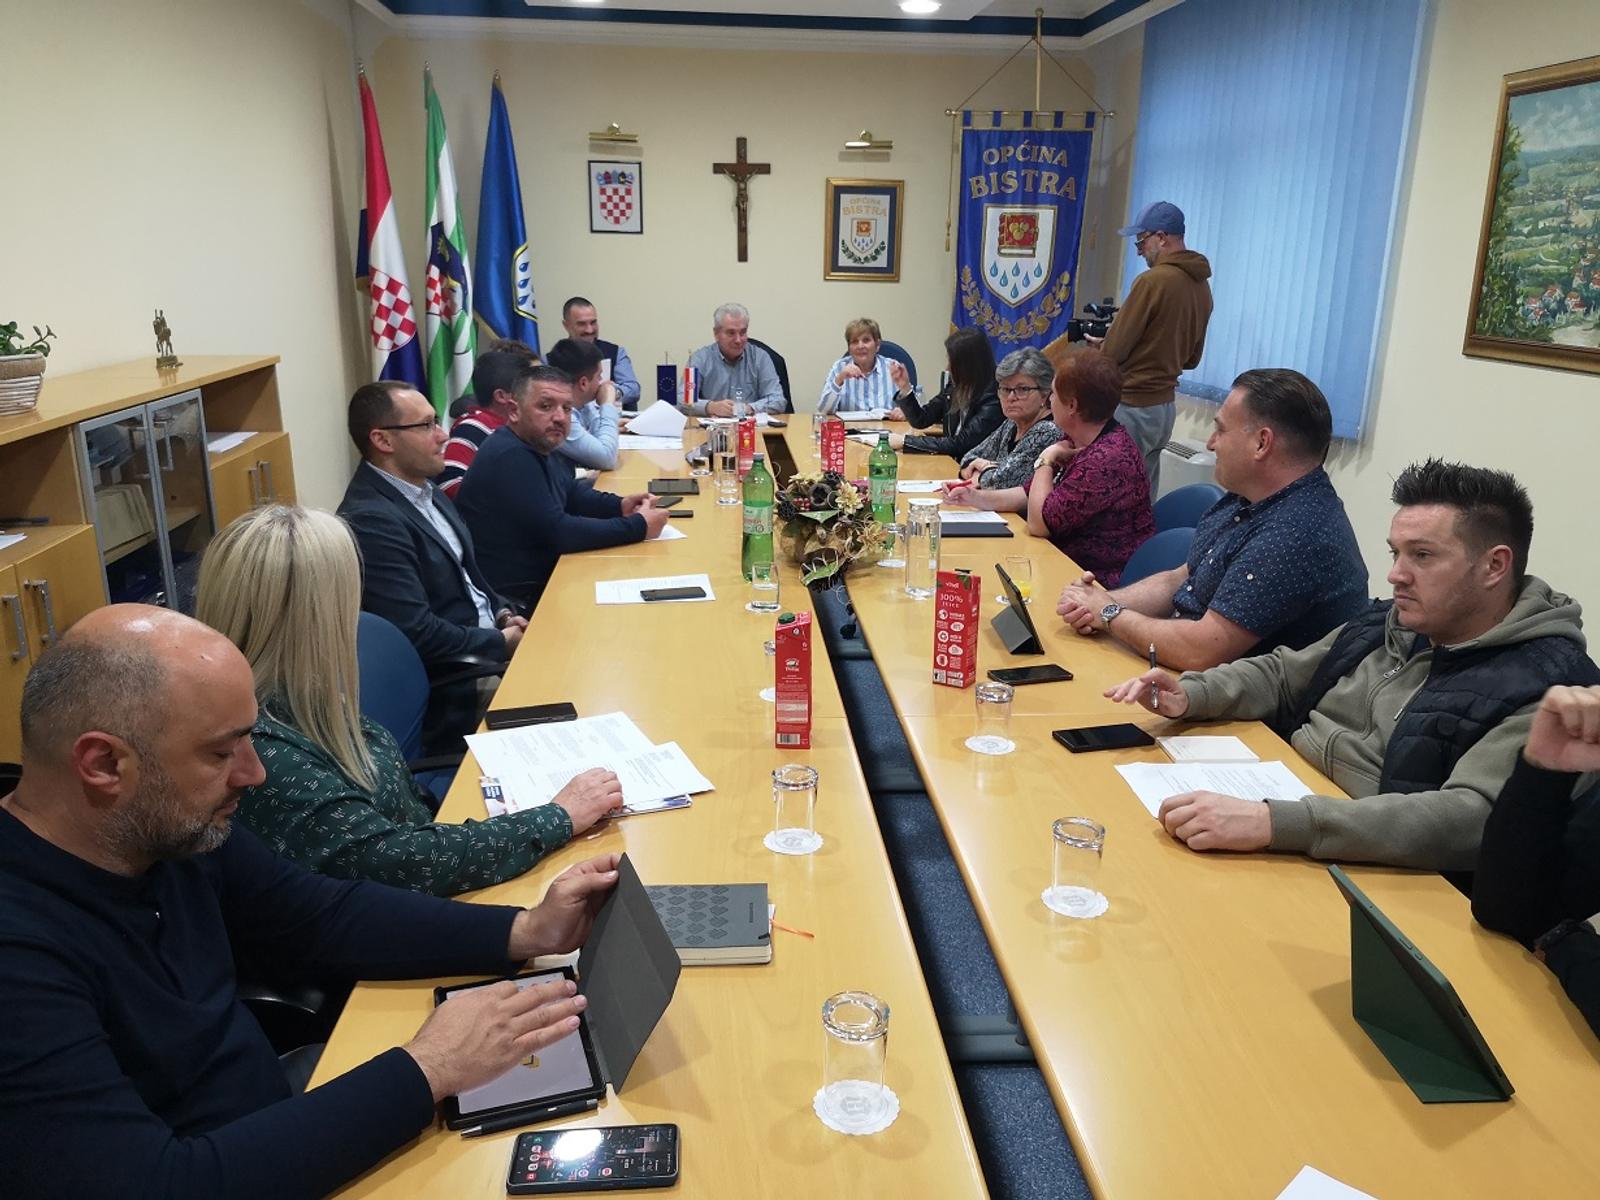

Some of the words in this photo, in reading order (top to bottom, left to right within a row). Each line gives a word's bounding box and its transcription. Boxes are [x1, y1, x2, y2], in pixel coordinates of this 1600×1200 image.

[983, 140, 1068, 167] OPĆINA
[969, 170, 1077, 200] BISTRA
[843, 207, 887, 216] BISTRA
[940, 593, 964, 602] 100%
